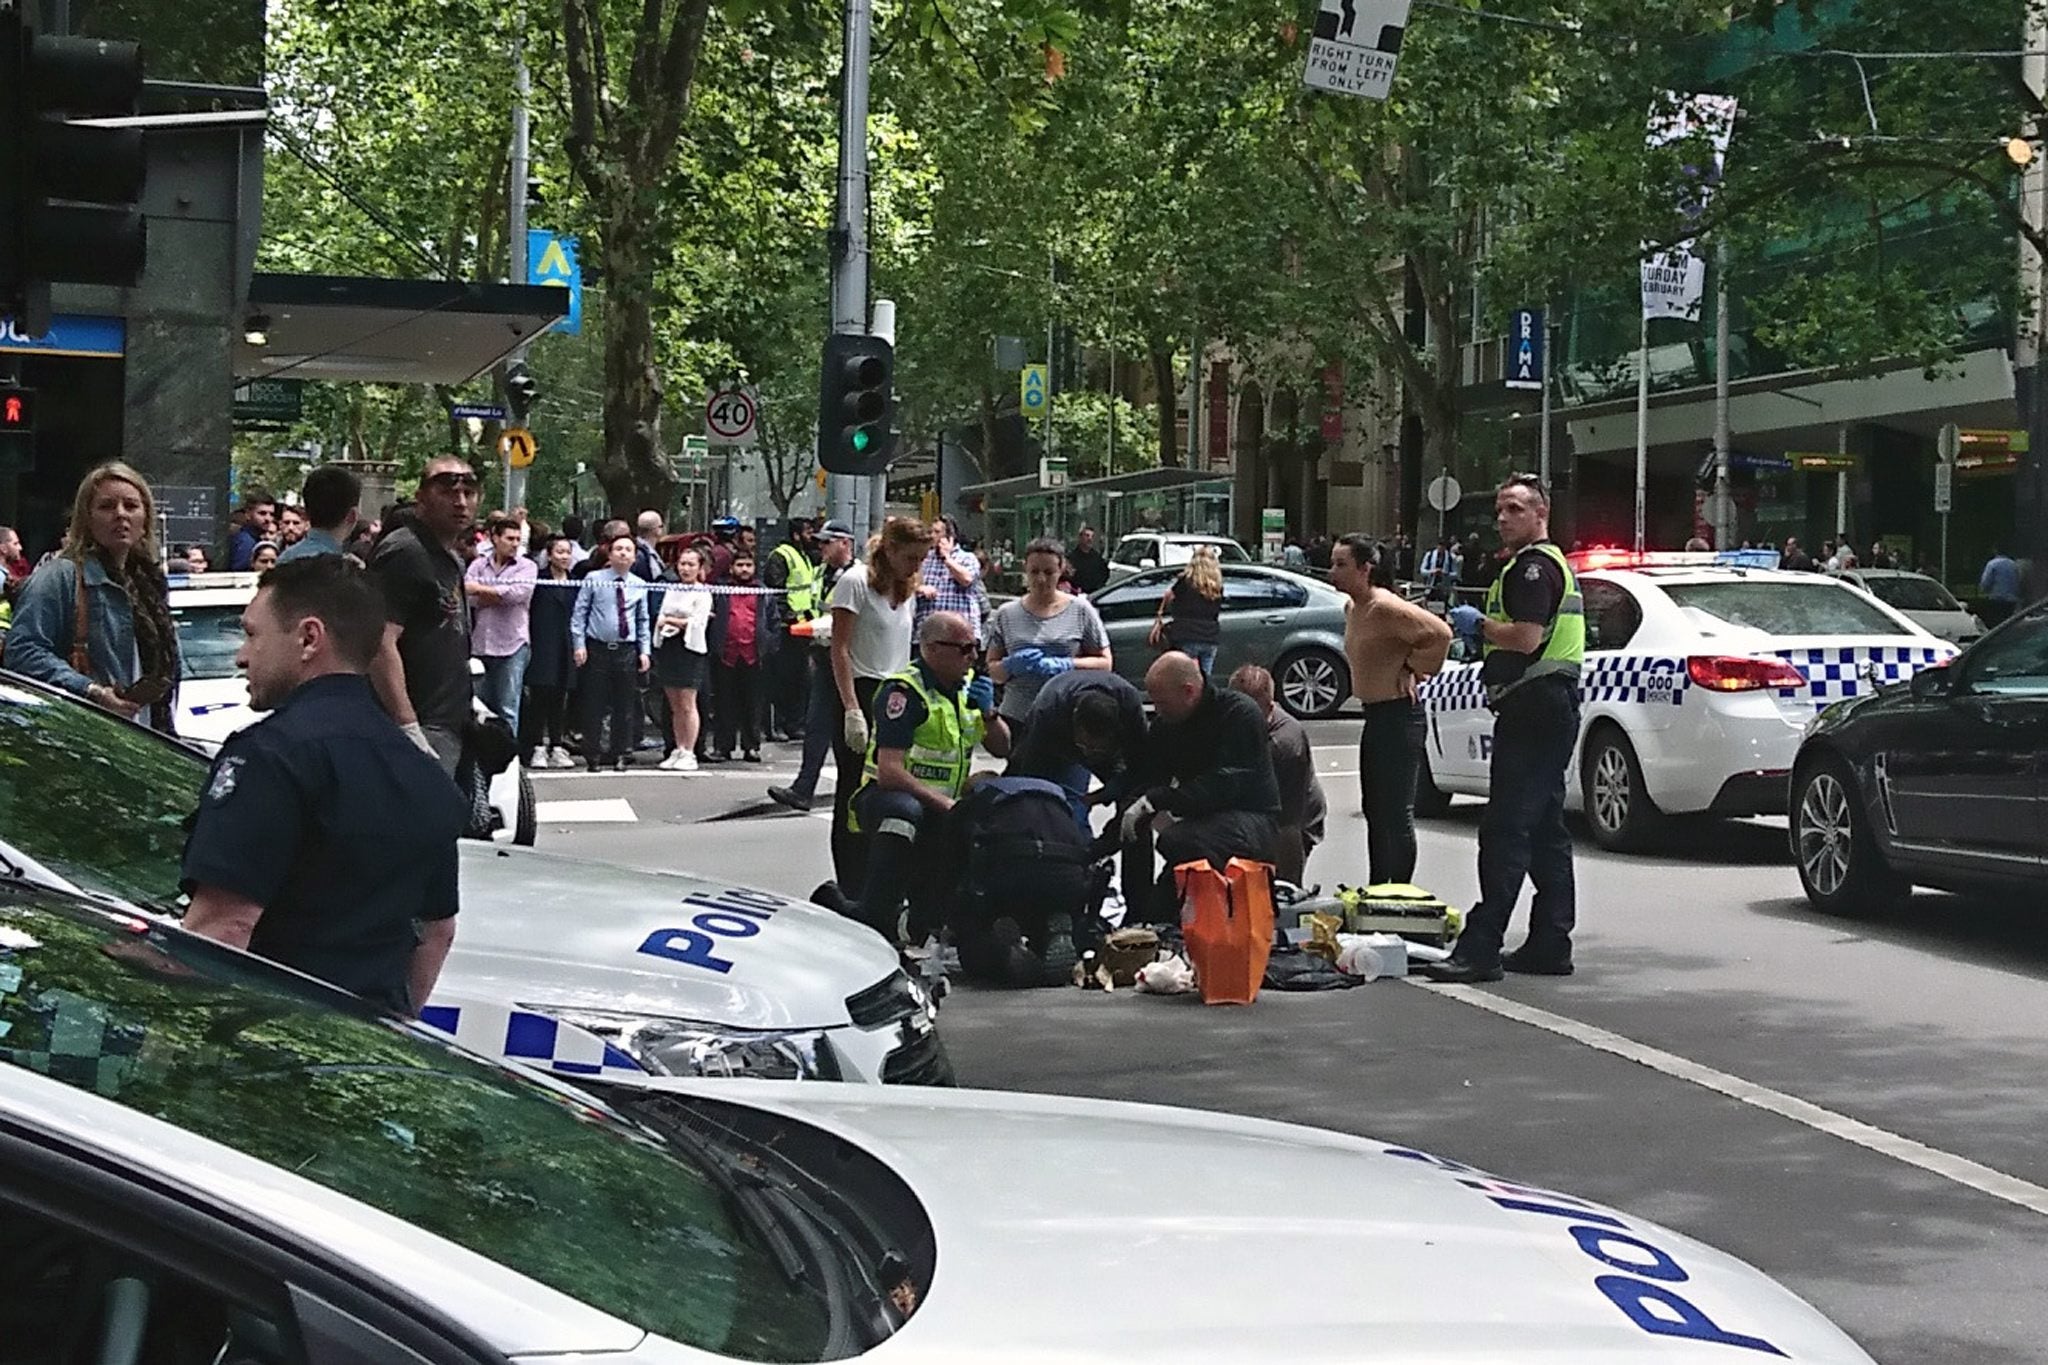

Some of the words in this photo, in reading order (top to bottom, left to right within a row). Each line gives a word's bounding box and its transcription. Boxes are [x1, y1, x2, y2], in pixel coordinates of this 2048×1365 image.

[1312, 44, 1352, 60] RIGHT
[1360, 53, 1393, 70] TURN
[1311, 58, 1347, 75] FROM
[1356, 68, 1387, 81] LEFT
[1328, 75, 1364, 90] ONLY
[1518, 311, 1533, 379] DRAMA
[712, 402, 749, 426] 40
[1647, 675, 1673, 690] 000
